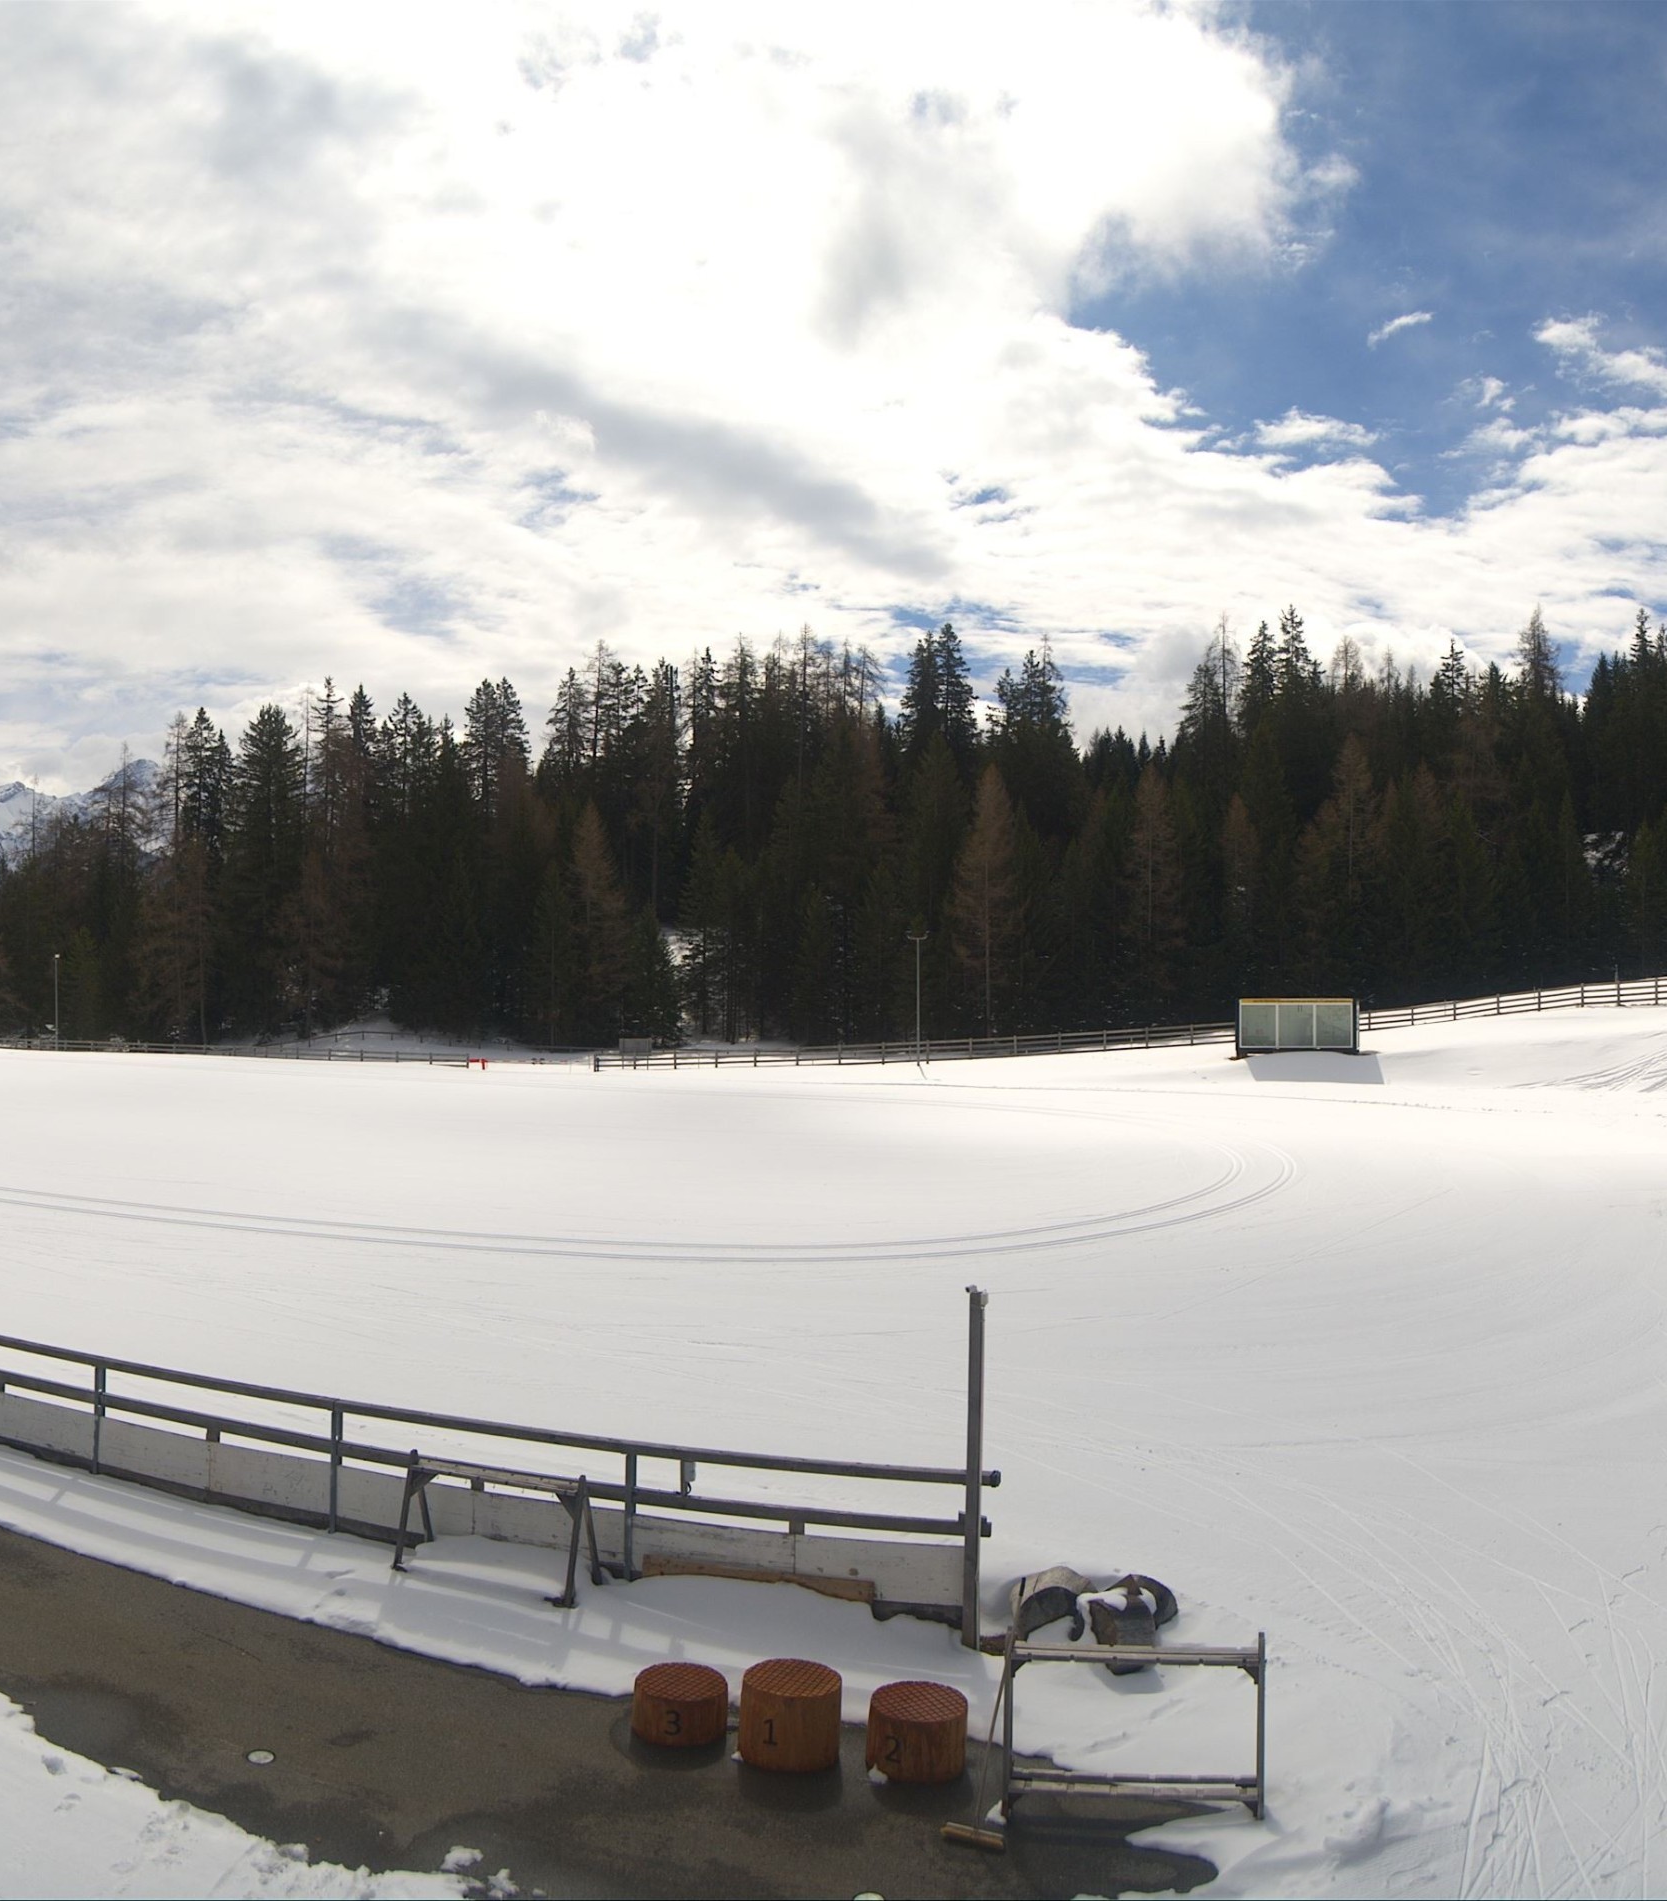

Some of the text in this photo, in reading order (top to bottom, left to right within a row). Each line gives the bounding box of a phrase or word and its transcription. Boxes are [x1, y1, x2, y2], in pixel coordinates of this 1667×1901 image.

[663, 1710, 681, 1736] 3
[763, 1718, 778, 1746] 1
[884, 1735, 902, 1764] 2
